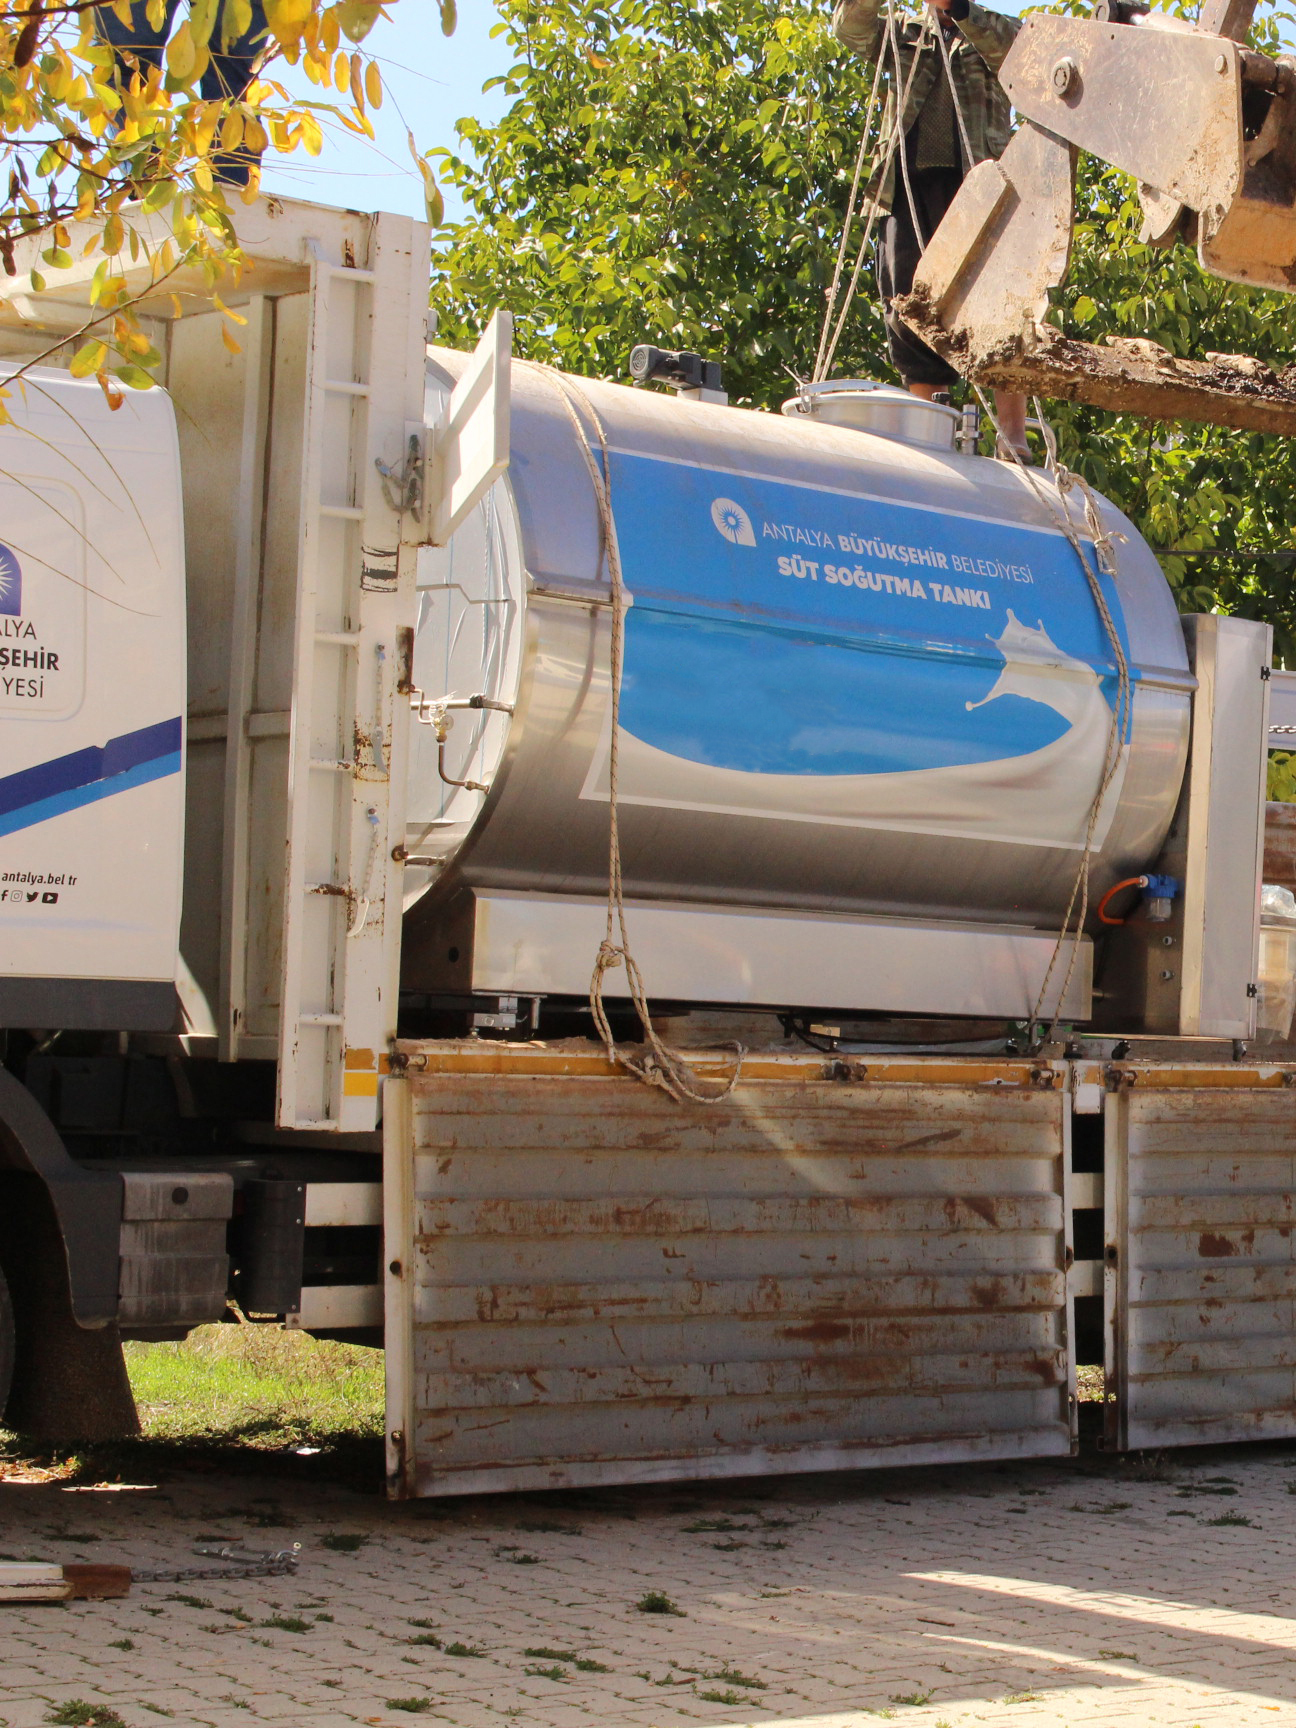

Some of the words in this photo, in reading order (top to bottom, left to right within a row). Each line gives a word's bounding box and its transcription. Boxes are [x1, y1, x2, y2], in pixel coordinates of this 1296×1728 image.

[762, 522, 835, 549] ANTALYA
[837, 533, 949, 569] BÜYÜKŞEHİR
[952, 555, 1034, 584] BELEDİYESİ
[777, 554, 819, 581] SÜT
[825, 564, 927, 599] SOĞUTMA
[929, 582, 991, 609] TANKI
[0, 619, 37, 640] LYA
